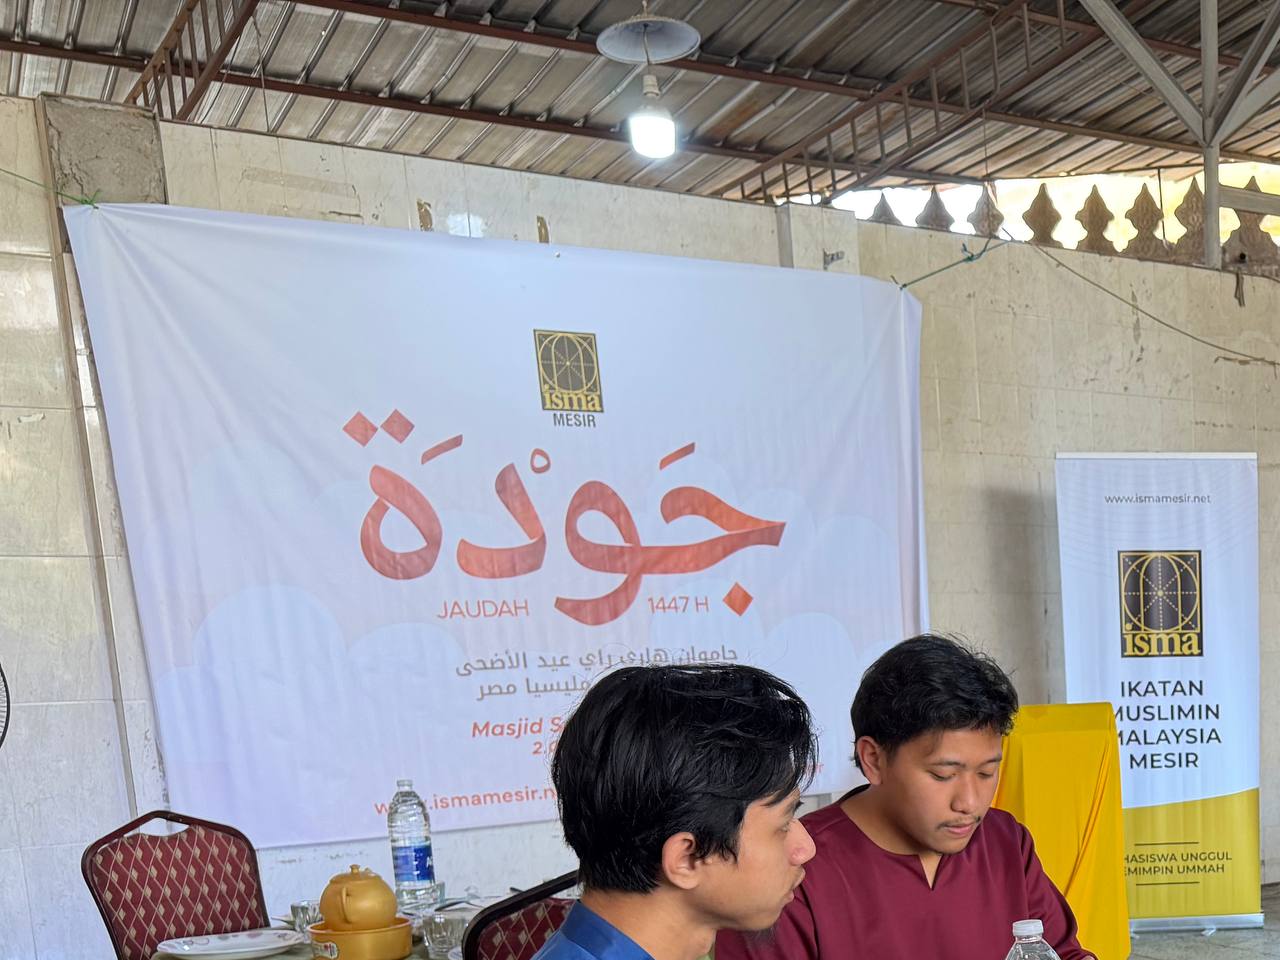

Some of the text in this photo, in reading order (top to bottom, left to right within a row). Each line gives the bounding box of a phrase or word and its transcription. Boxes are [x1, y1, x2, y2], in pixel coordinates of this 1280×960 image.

[543, 384, 602, 411] isma
[552, 412, 597, 428] MESIR
[1104, 493, 1211, 504] www.ismamesir.net
[437, 599, 530, 619] JAUDAH
[647, 596, 709, 613] 1447 H
[1123, 622, 1202, 656] isma
[537, 654, 569, 672] عيد
[477, 682, 517, 701] مصر
[1120, 680, 1204, 698] IKATAN
[471, 717, 543, 739] Masjid
[1129, 752, 1199, 769] MESIR
[1181, 851, 1232, 862] UNGGUL
[1177, 864, 1225, 874] UMMAH
